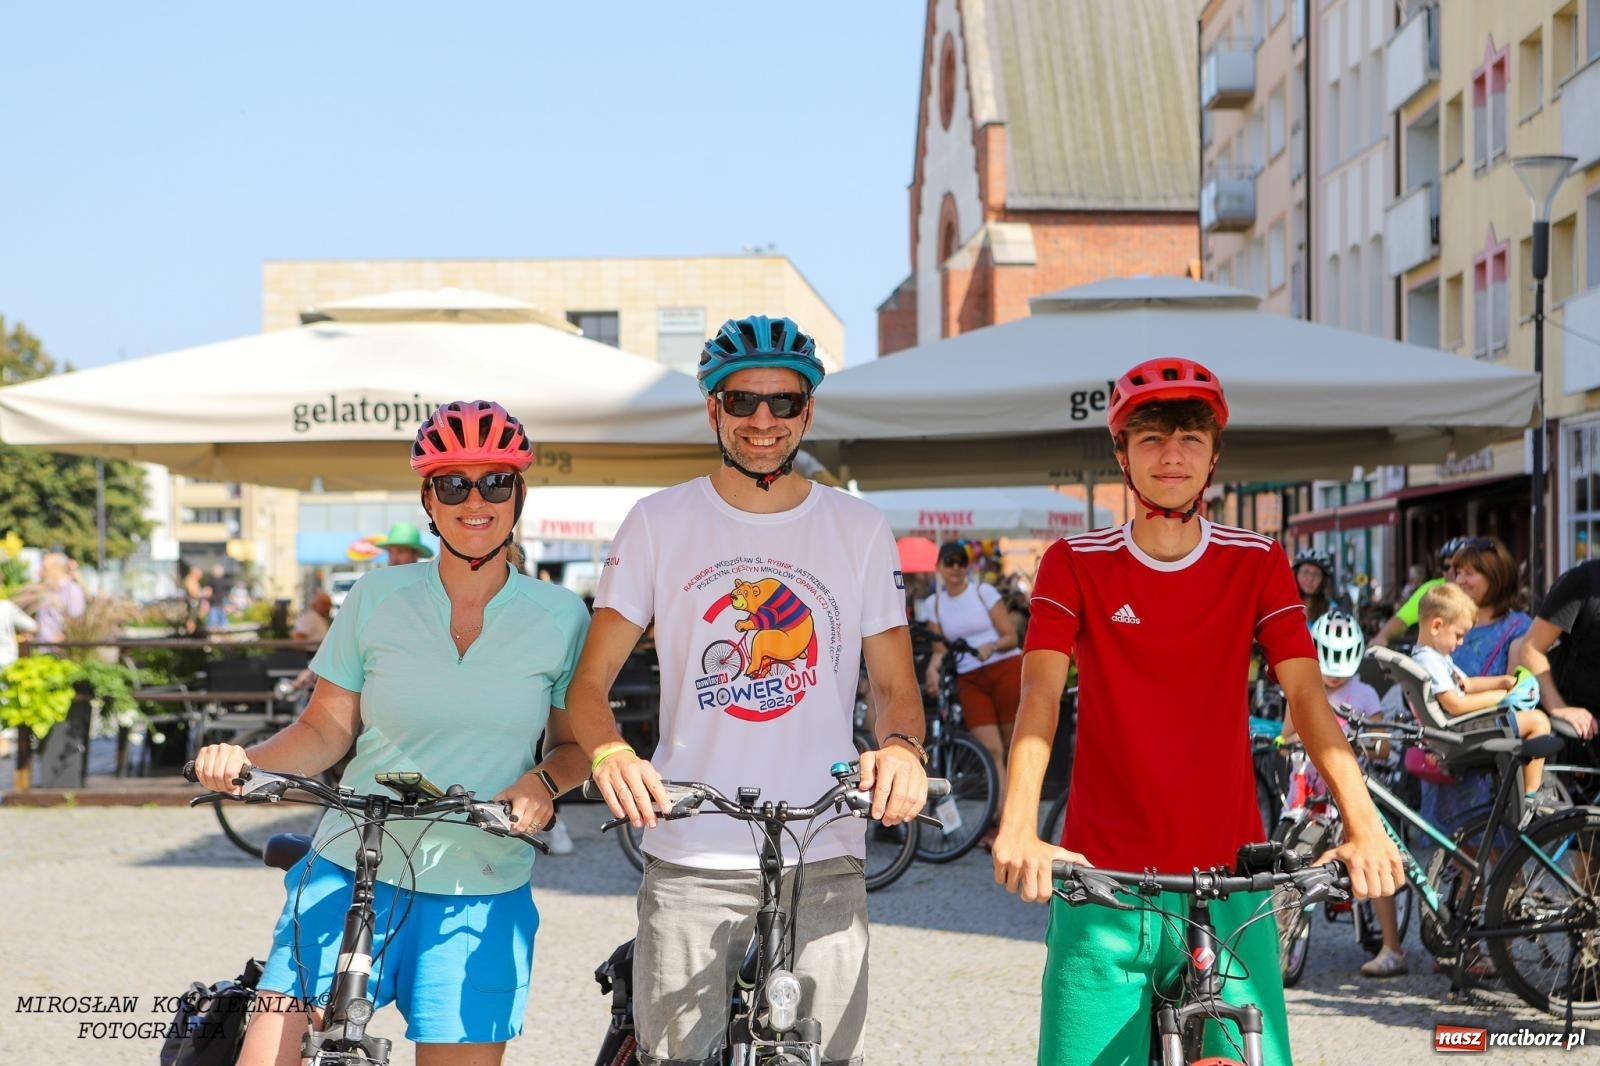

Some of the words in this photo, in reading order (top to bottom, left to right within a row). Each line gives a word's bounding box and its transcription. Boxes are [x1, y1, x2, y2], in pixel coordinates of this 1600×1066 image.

[767, 558, 794, 570] RYBNIK
[696, 569, 732, 590] PSZCZYNA
[731, 564, 759, 574] CIESZYN
[795, 577, 817, 597] OPAWA
[1111, 615, 1141, 625] adidas
[759, 694, 794, 711] 2024
